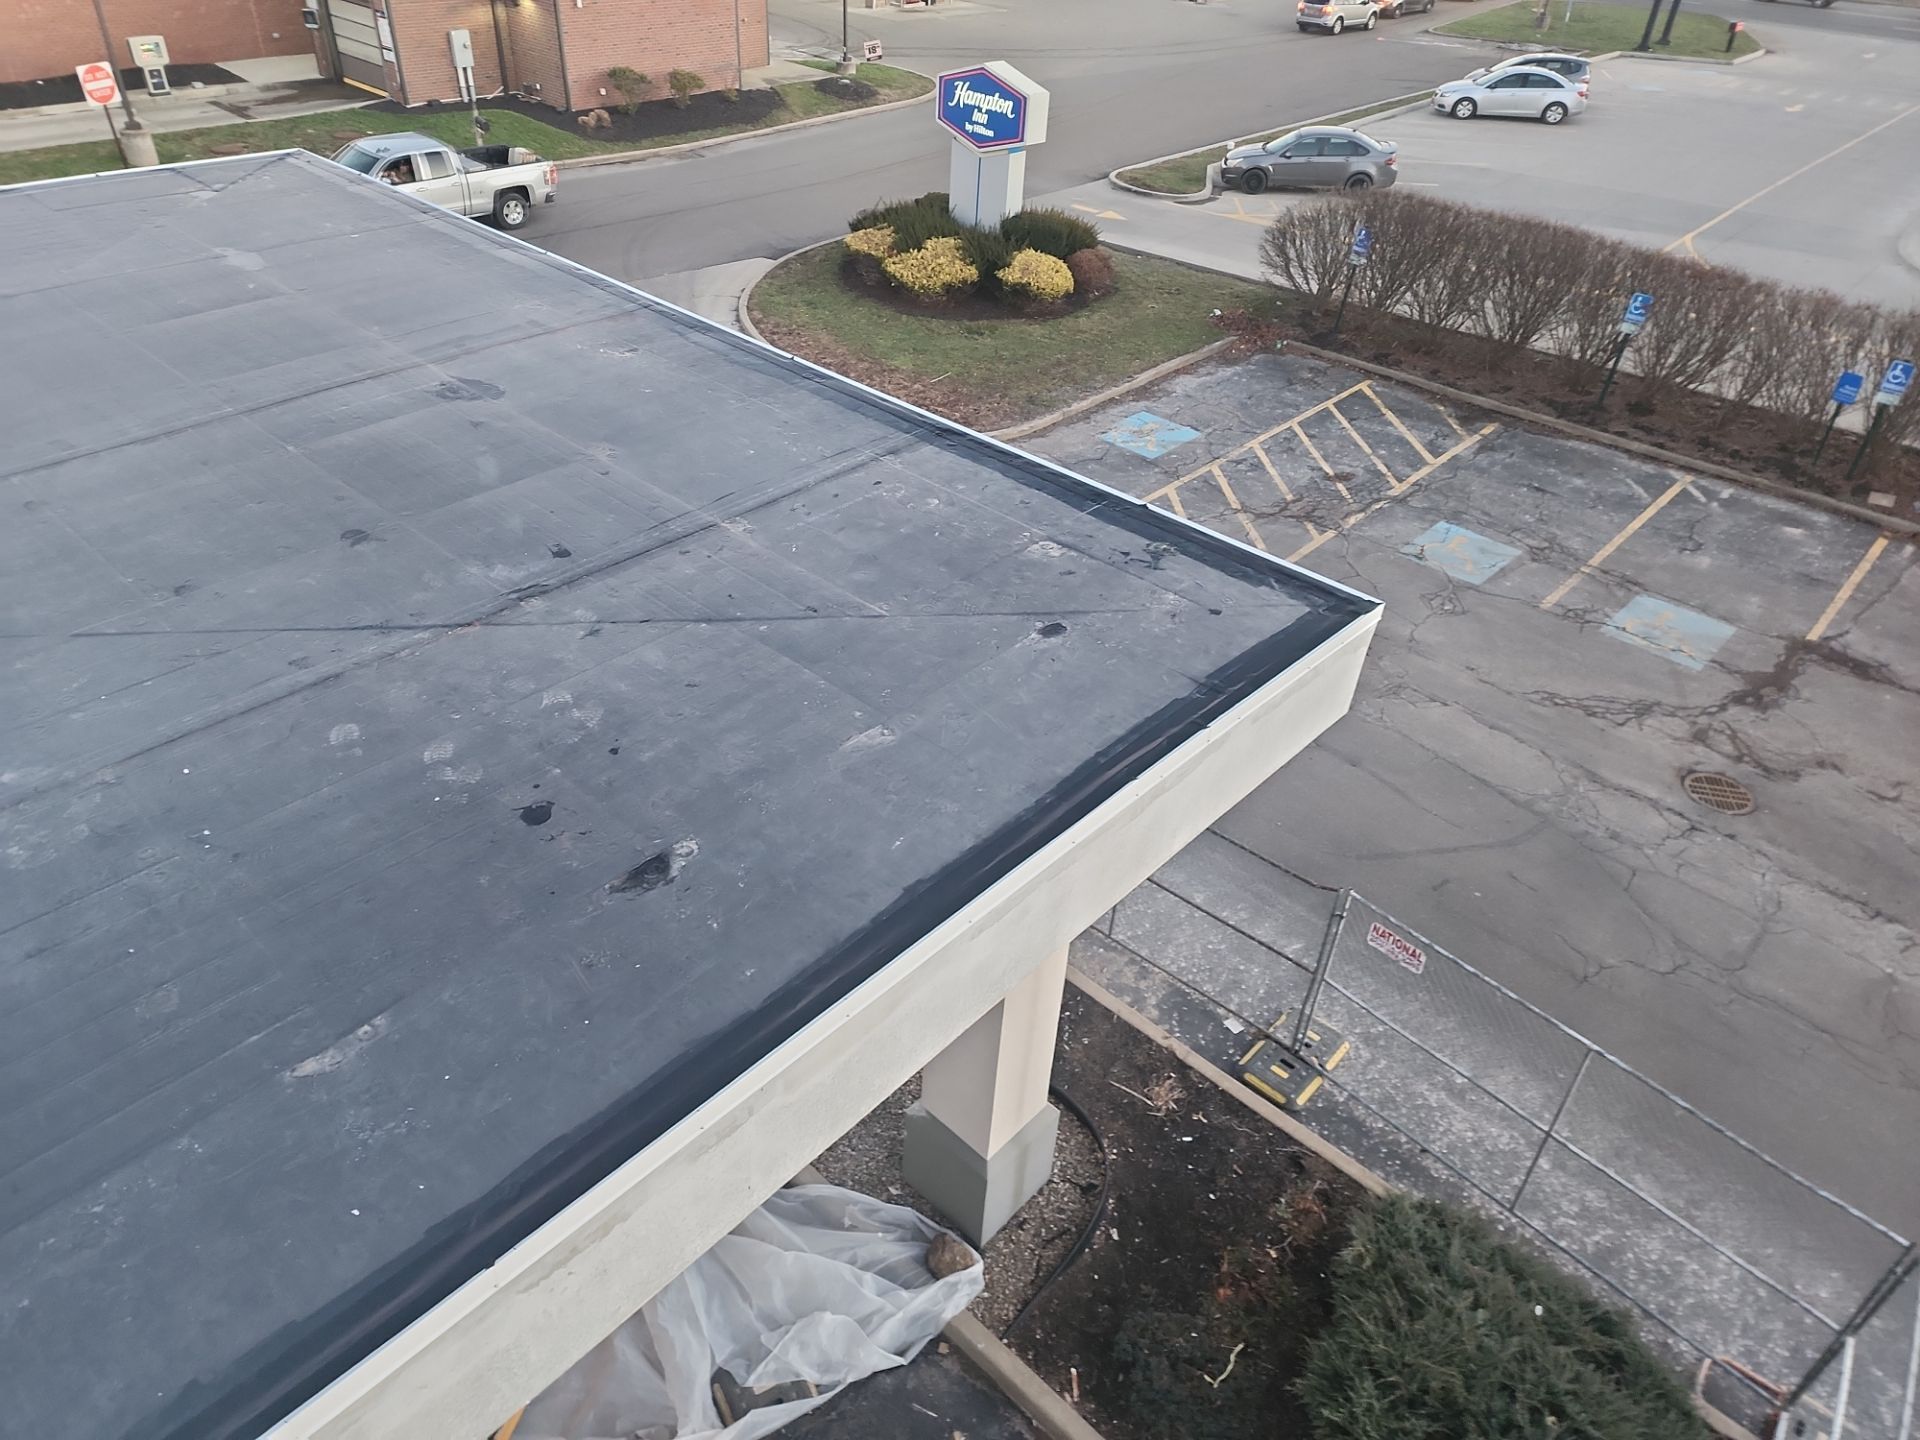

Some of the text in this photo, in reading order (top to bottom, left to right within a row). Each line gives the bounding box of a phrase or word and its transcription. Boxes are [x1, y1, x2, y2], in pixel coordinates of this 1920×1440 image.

[948, 81, 1015, 118] Hampton
[965, 122, 994, 137] by Hilton
[972, 109, 988, 124] Inn
[1372, 924, 1422, 963] NATIONAL
